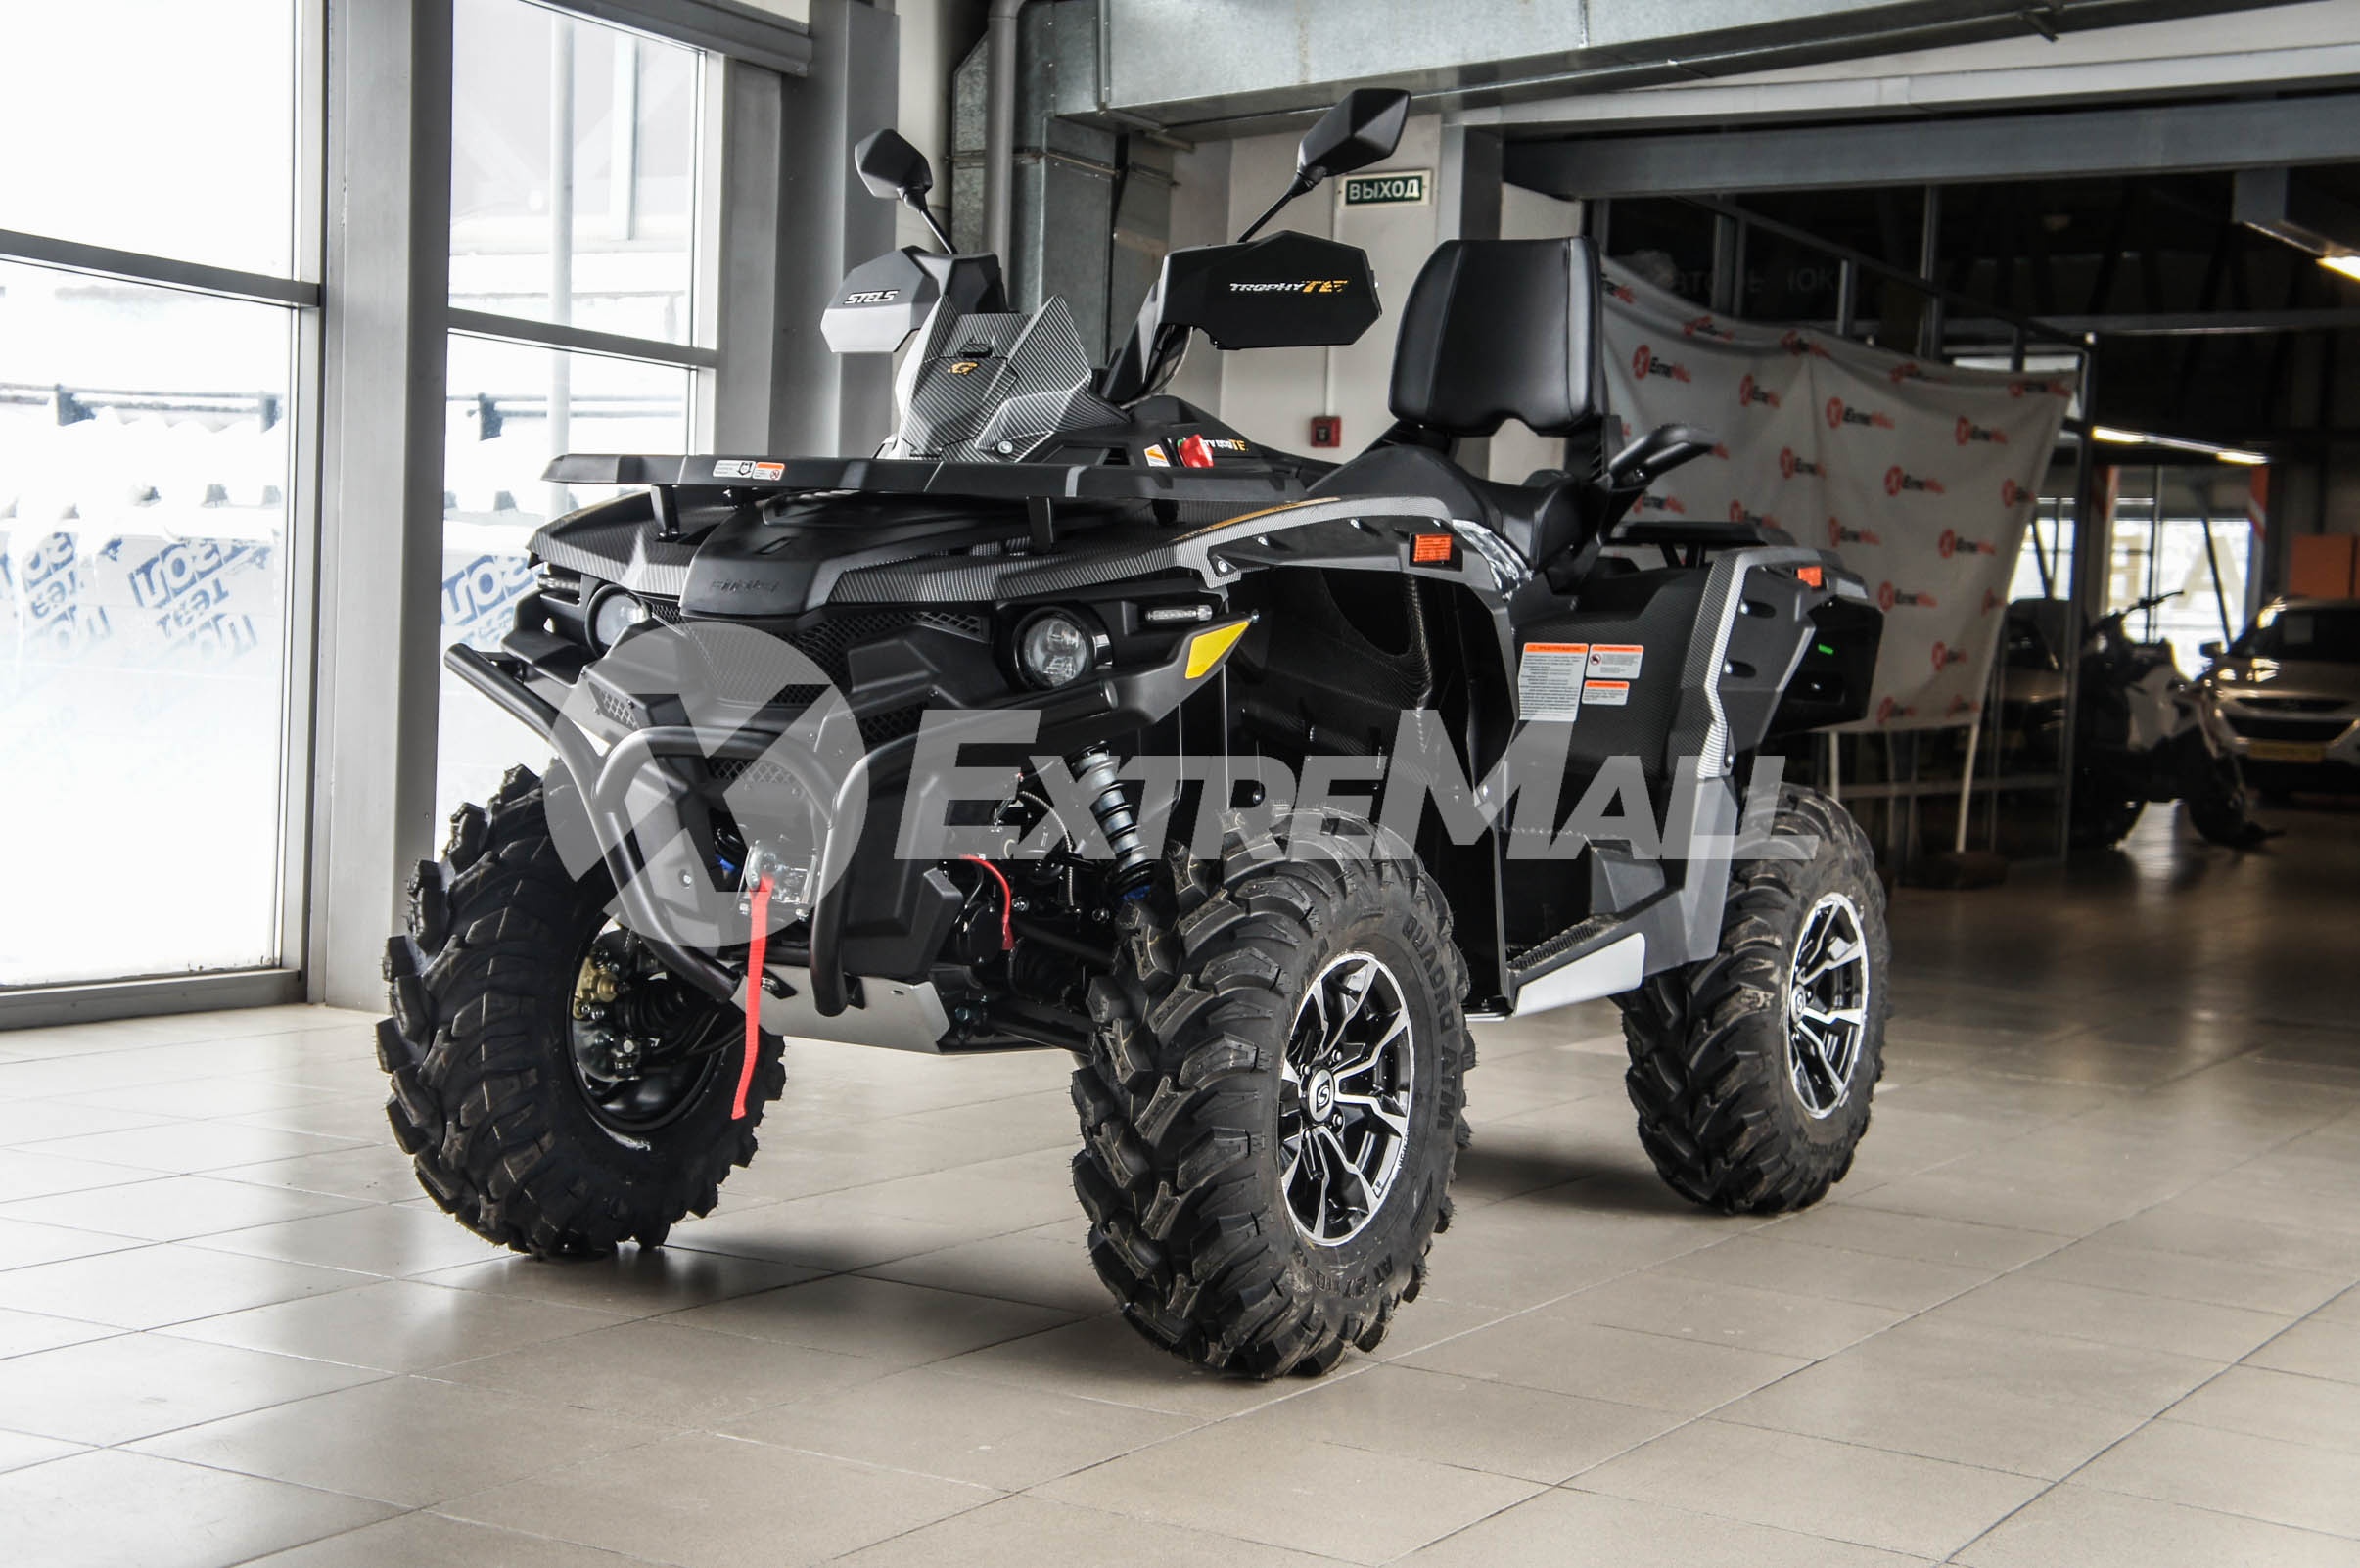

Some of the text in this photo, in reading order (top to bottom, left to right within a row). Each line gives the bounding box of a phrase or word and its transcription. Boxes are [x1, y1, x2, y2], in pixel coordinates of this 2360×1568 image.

[1348, 179, 1420, 201] ВЫХОД
[1229, 282, 1305, 292] TROPHY
[843, 289, 900, 305] STELS
